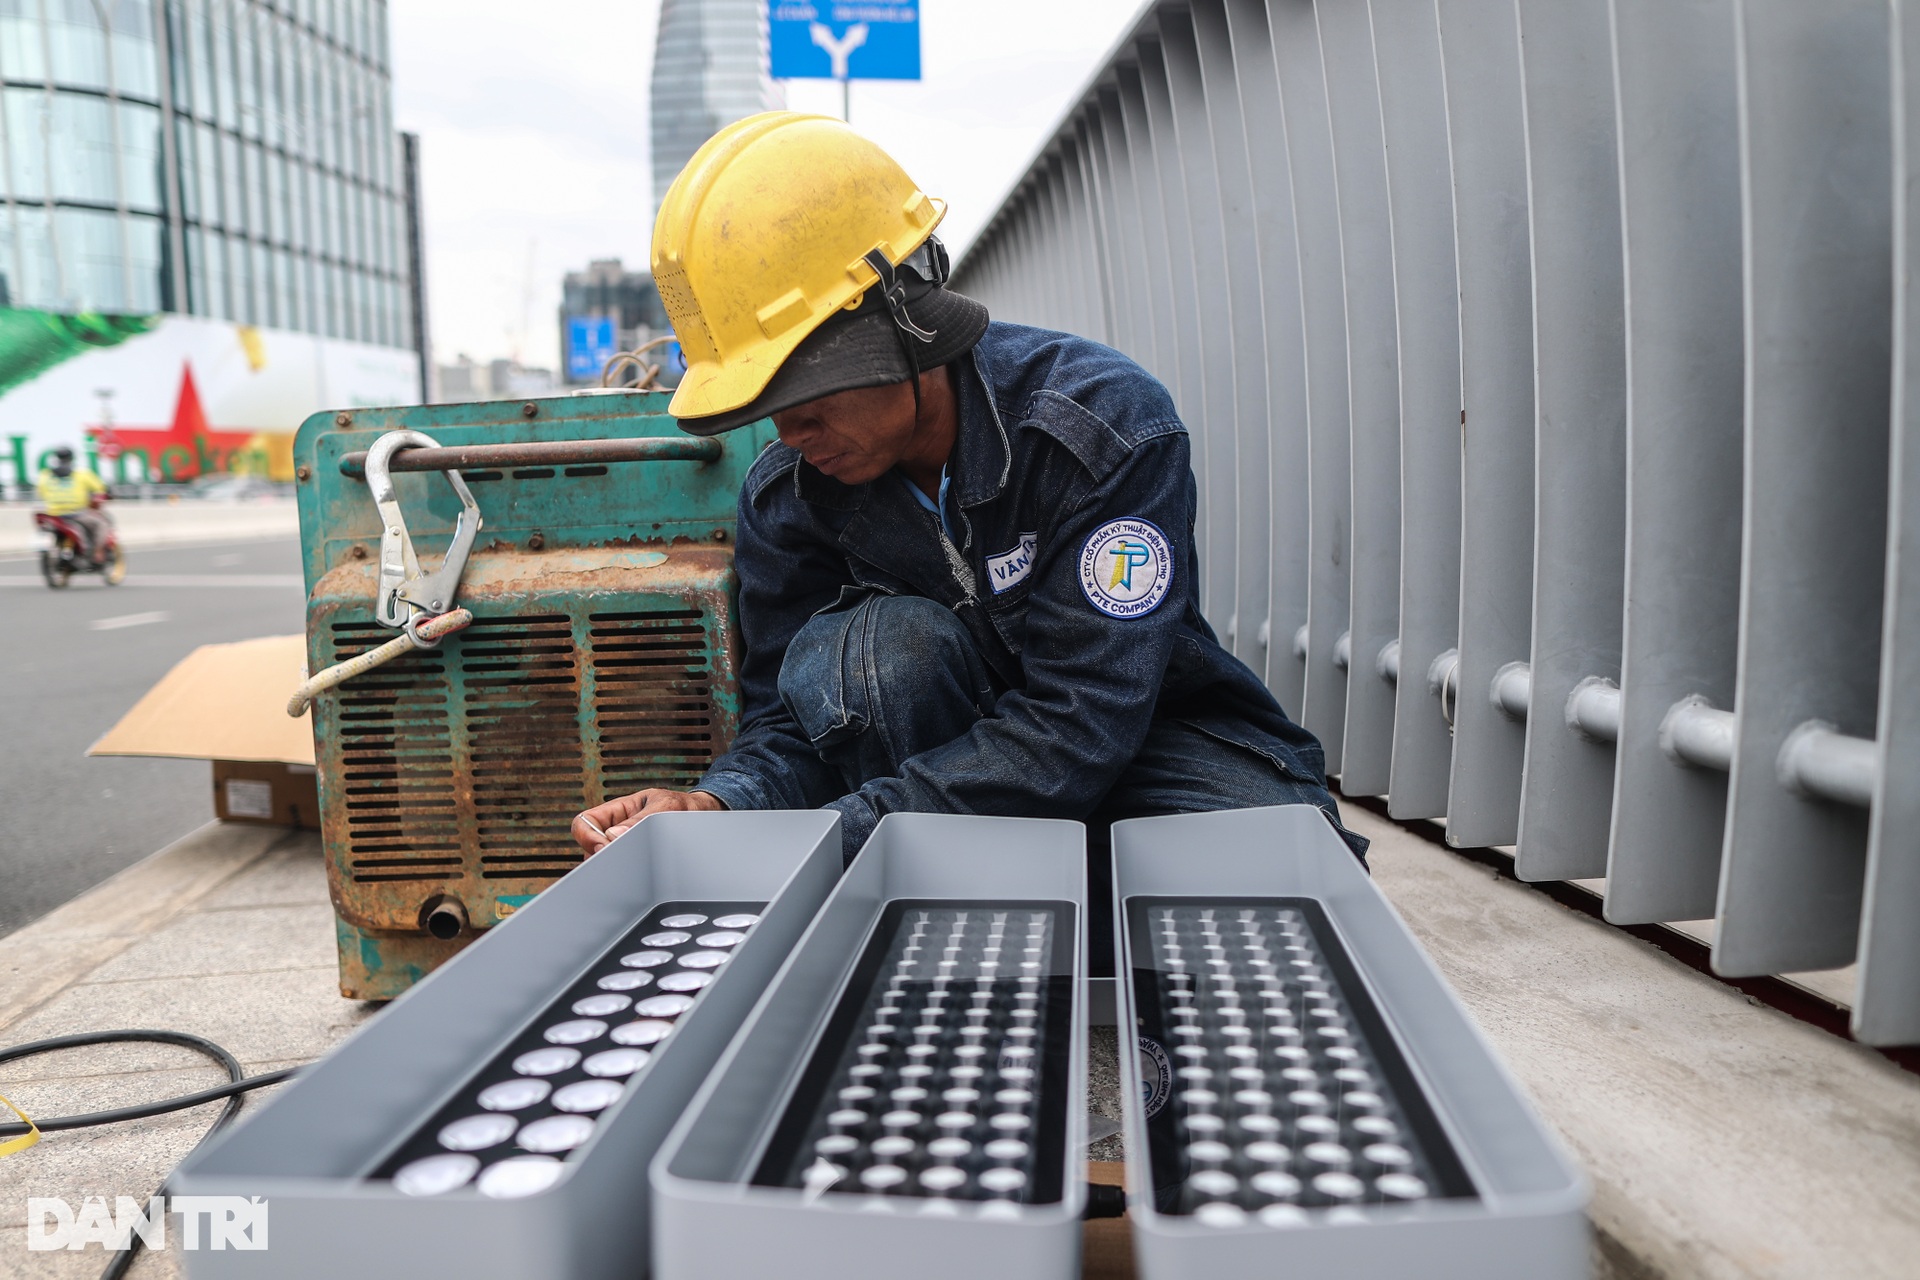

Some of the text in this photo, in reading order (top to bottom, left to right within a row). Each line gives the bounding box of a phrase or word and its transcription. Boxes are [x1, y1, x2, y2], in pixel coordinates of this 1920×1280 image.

[1158, 563, 1167, 580] THỌ
[1090, 591, 1157, 614] PTE COMPANY
